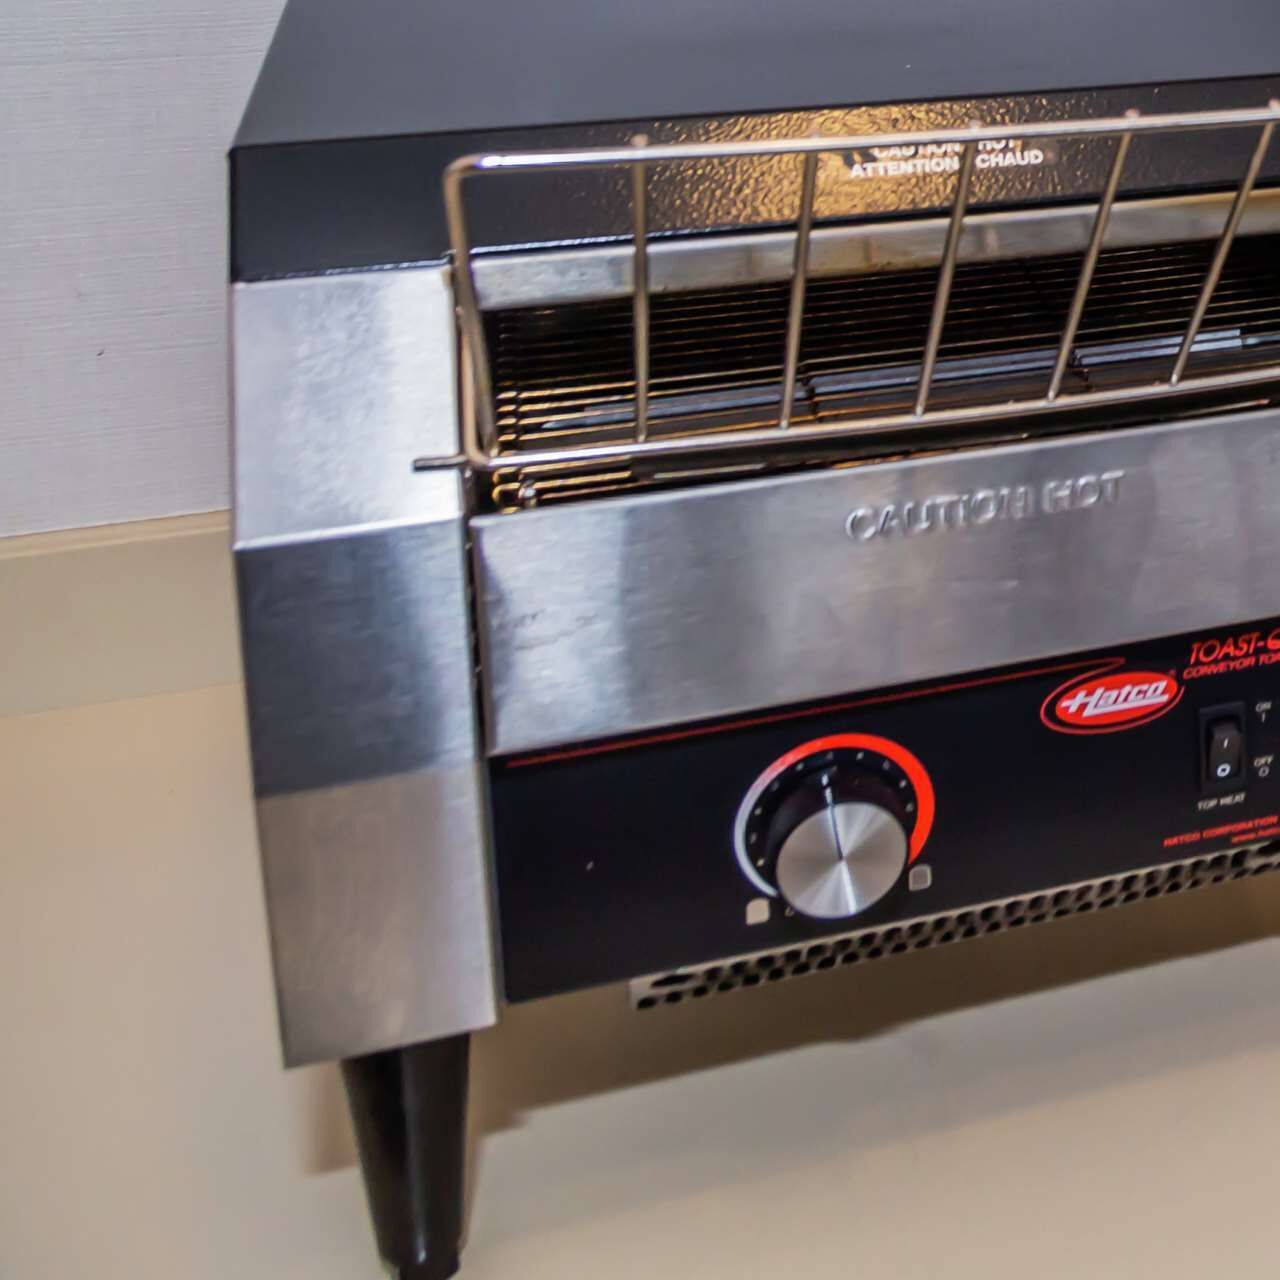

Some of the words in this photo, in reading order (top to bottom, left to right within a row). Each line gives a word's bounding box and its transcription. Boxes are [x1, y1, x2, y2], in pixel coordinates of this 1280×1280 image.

[850, 156, 960, 178] ATTENTION
[975, 149, 1044, 169] CHAUD
[845, 484, 1036, 541] CAUTION
[1042, 470, 1126, 516] HOT
[1182, 655, 1257, 681] CONVEYOR
[1060, 679, 1169, 718] Hatco
[1255, 701, 1273, 713] ON
[1253, 754, 1275, 768] OFF
[1197, 798, 1218, 812] TOP
[1219, 791, 1247, 807] HEAT
